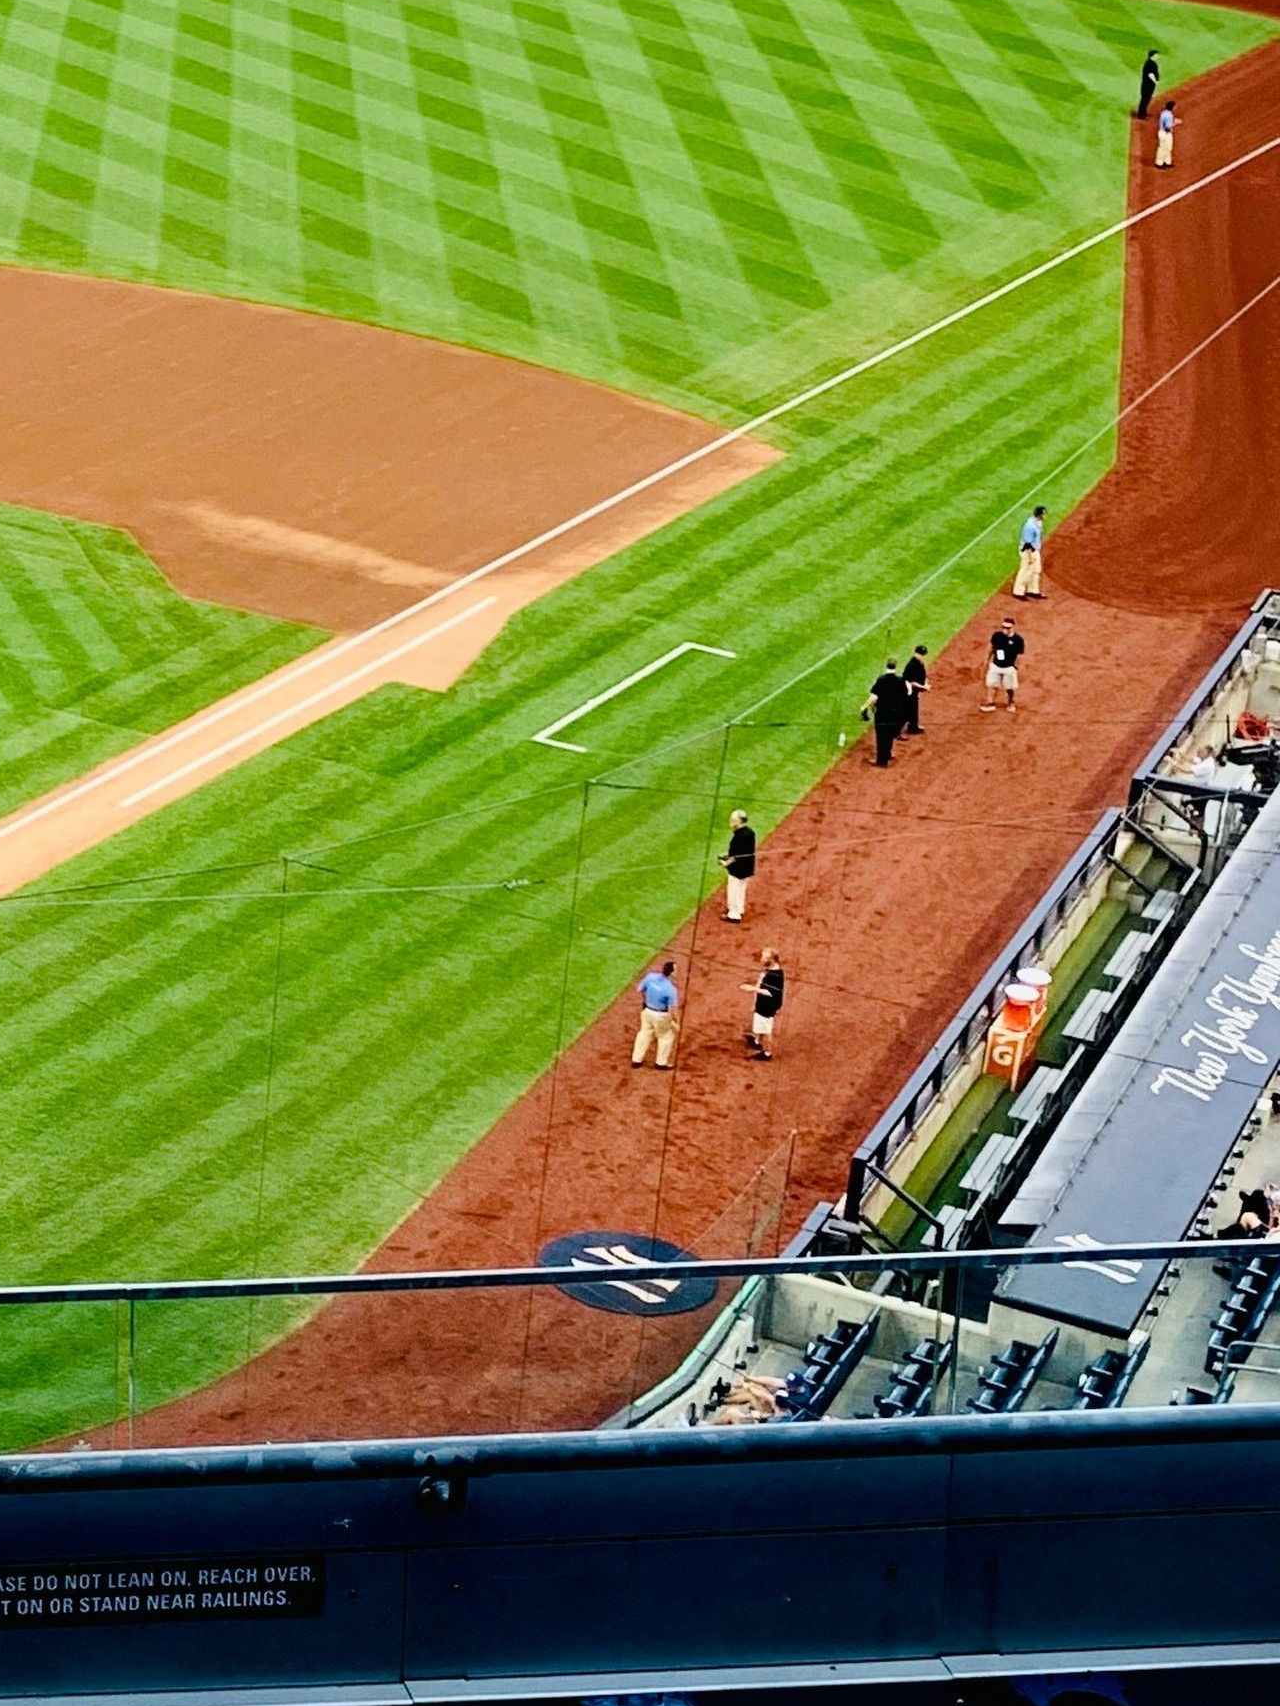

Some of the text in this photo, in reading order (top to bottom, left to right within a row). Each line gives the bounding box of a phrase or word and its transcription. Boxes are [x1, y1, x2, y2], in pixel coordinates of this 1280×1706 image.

[1149, 1050, 1229, 1102] New
[32, 1574, 59, 1592] DO
[64, 1573, 103, 1590] NOT
[107, 1571, 155, 1589] LEAN
[197, 1567, 258, 1586] REACH
[263, 1565, 317, 1584] OVER,
[16, 1598, 44, 1616] ON
[49, 1597, 74, 1615] OR
[78, 1595, 141, 1613] STAND
[146, 1592, 197, 1611] NEAR
[200, 1589, 293, 1610] RAILINGS.
